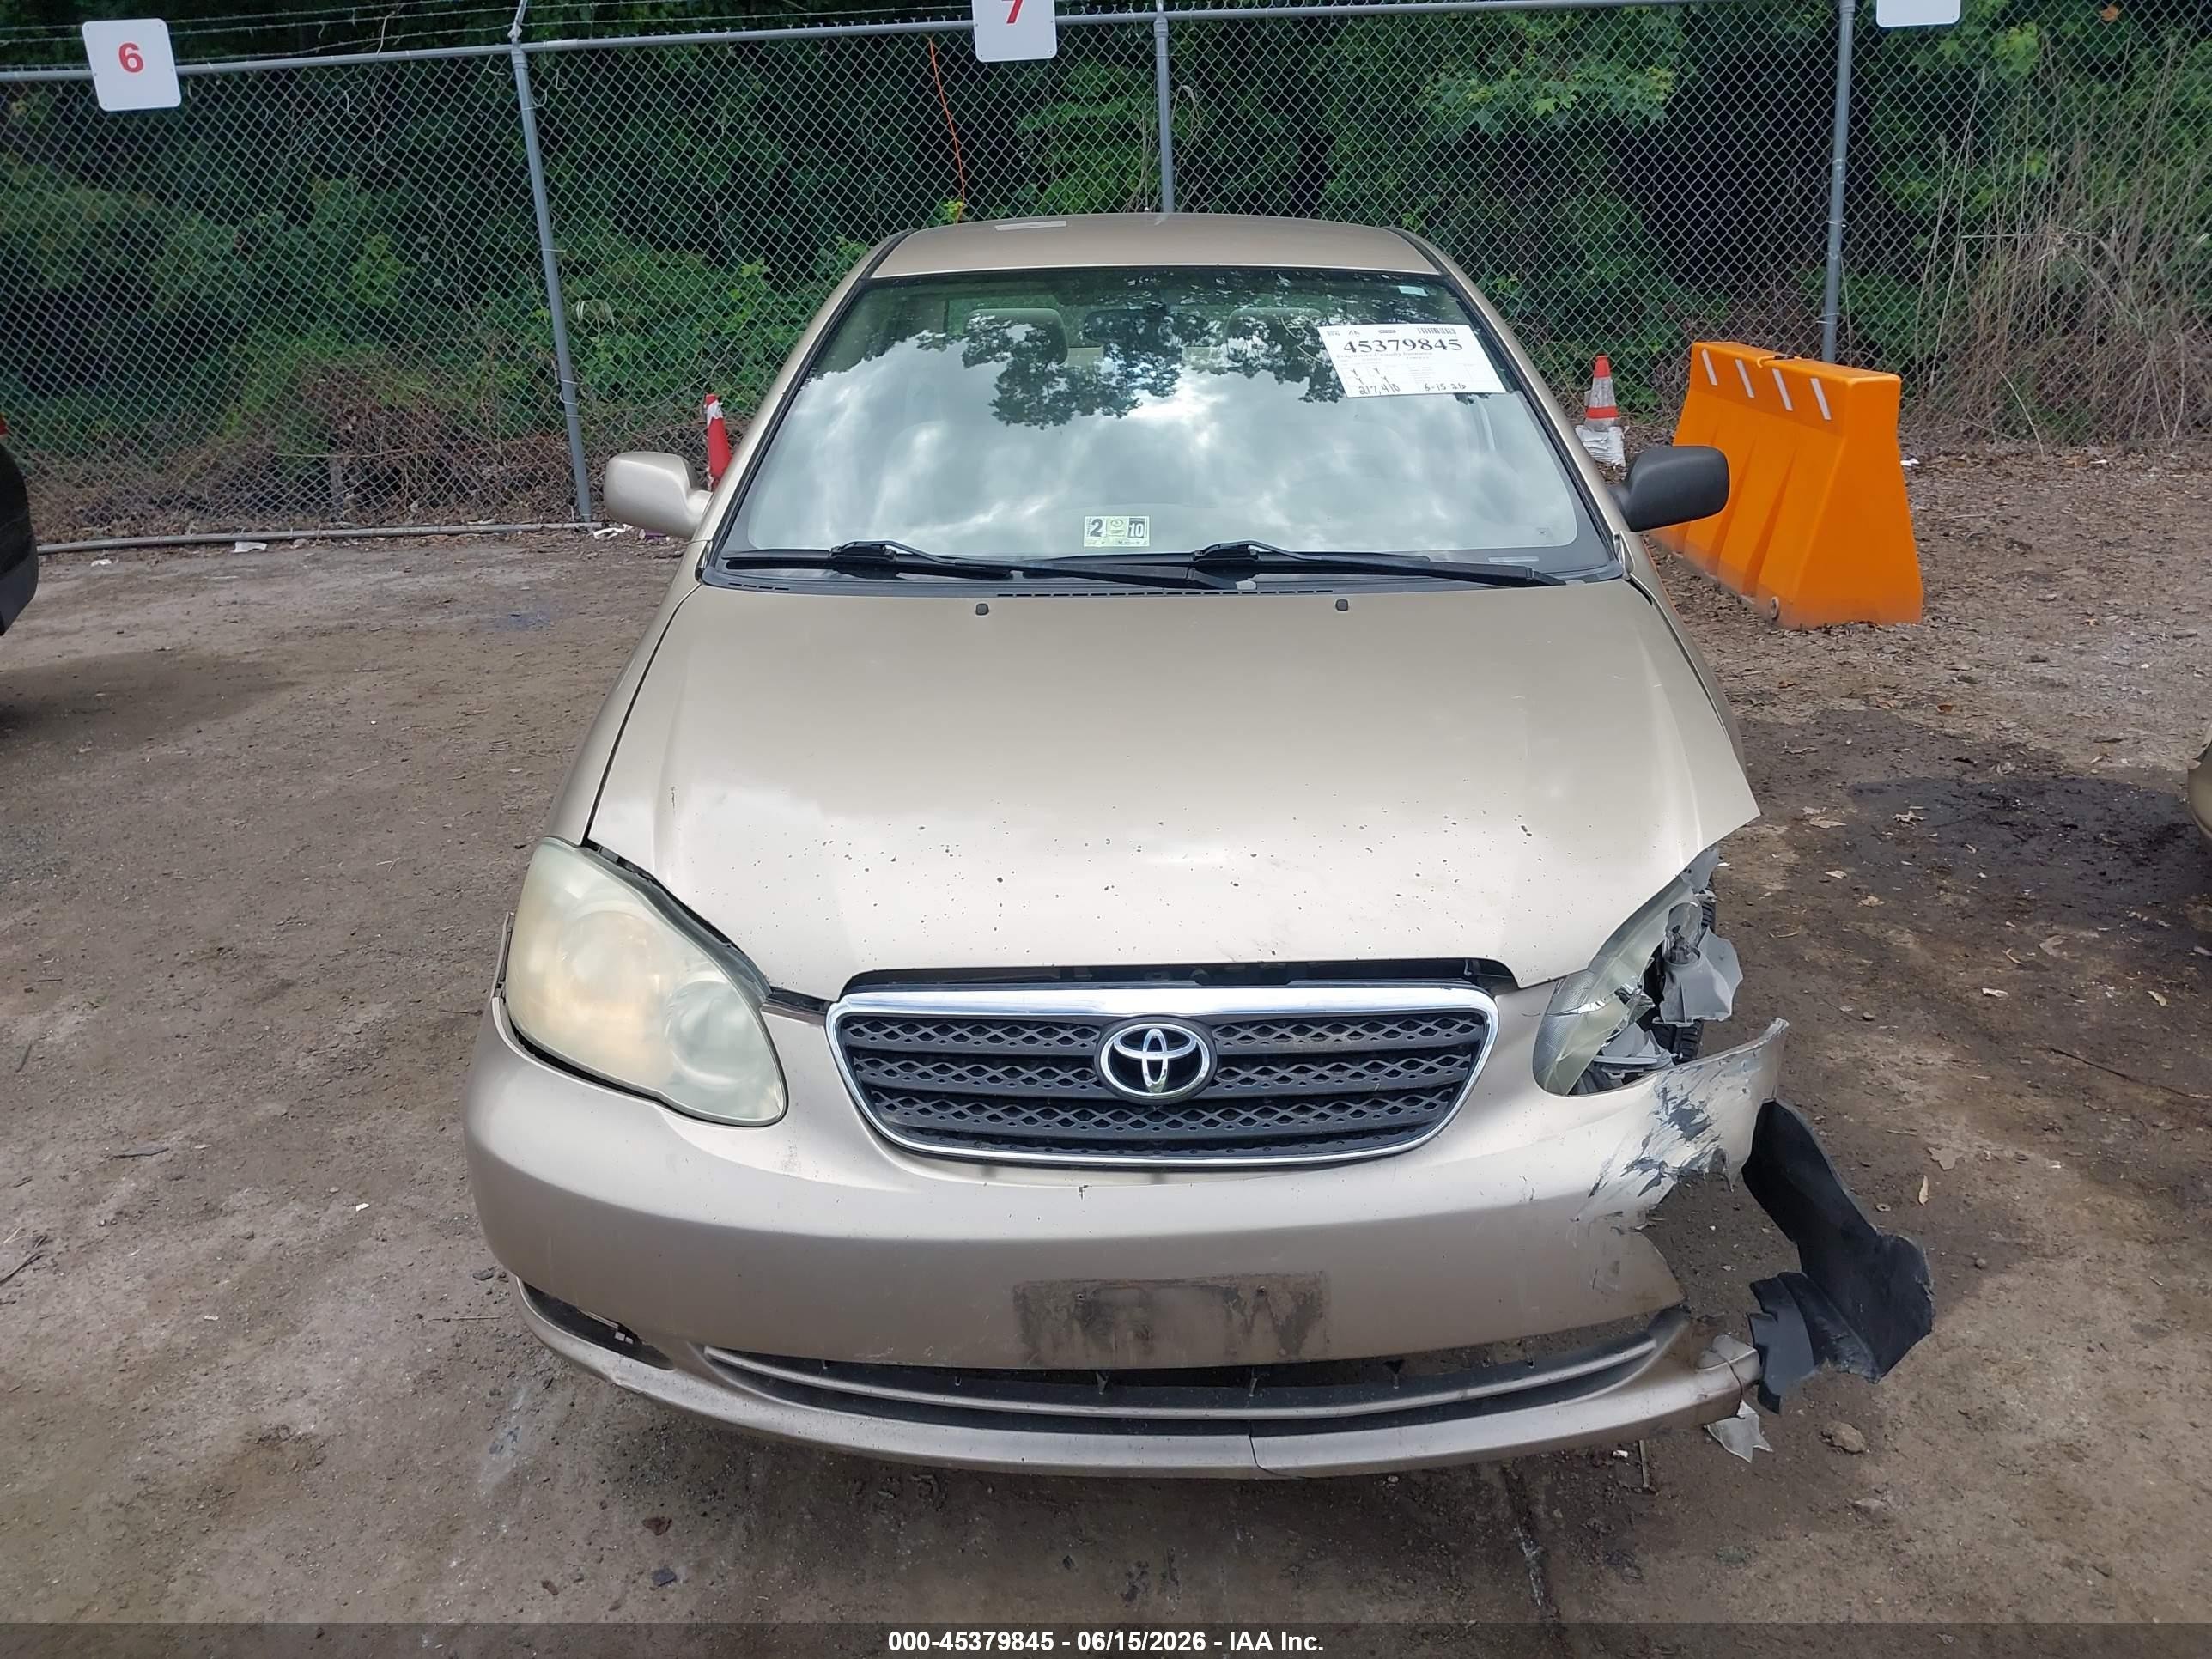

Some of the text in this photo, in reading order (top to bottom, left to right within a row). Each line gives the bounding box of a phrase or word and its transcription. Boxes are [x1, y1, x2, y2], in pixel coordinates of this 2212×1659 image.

[118, 42, 144, 73] 6
[1343, 337, 1463, 353] 45379845
[1090, 519, 1103, 537] 2
[1129, 523, 1144, 537] 10
